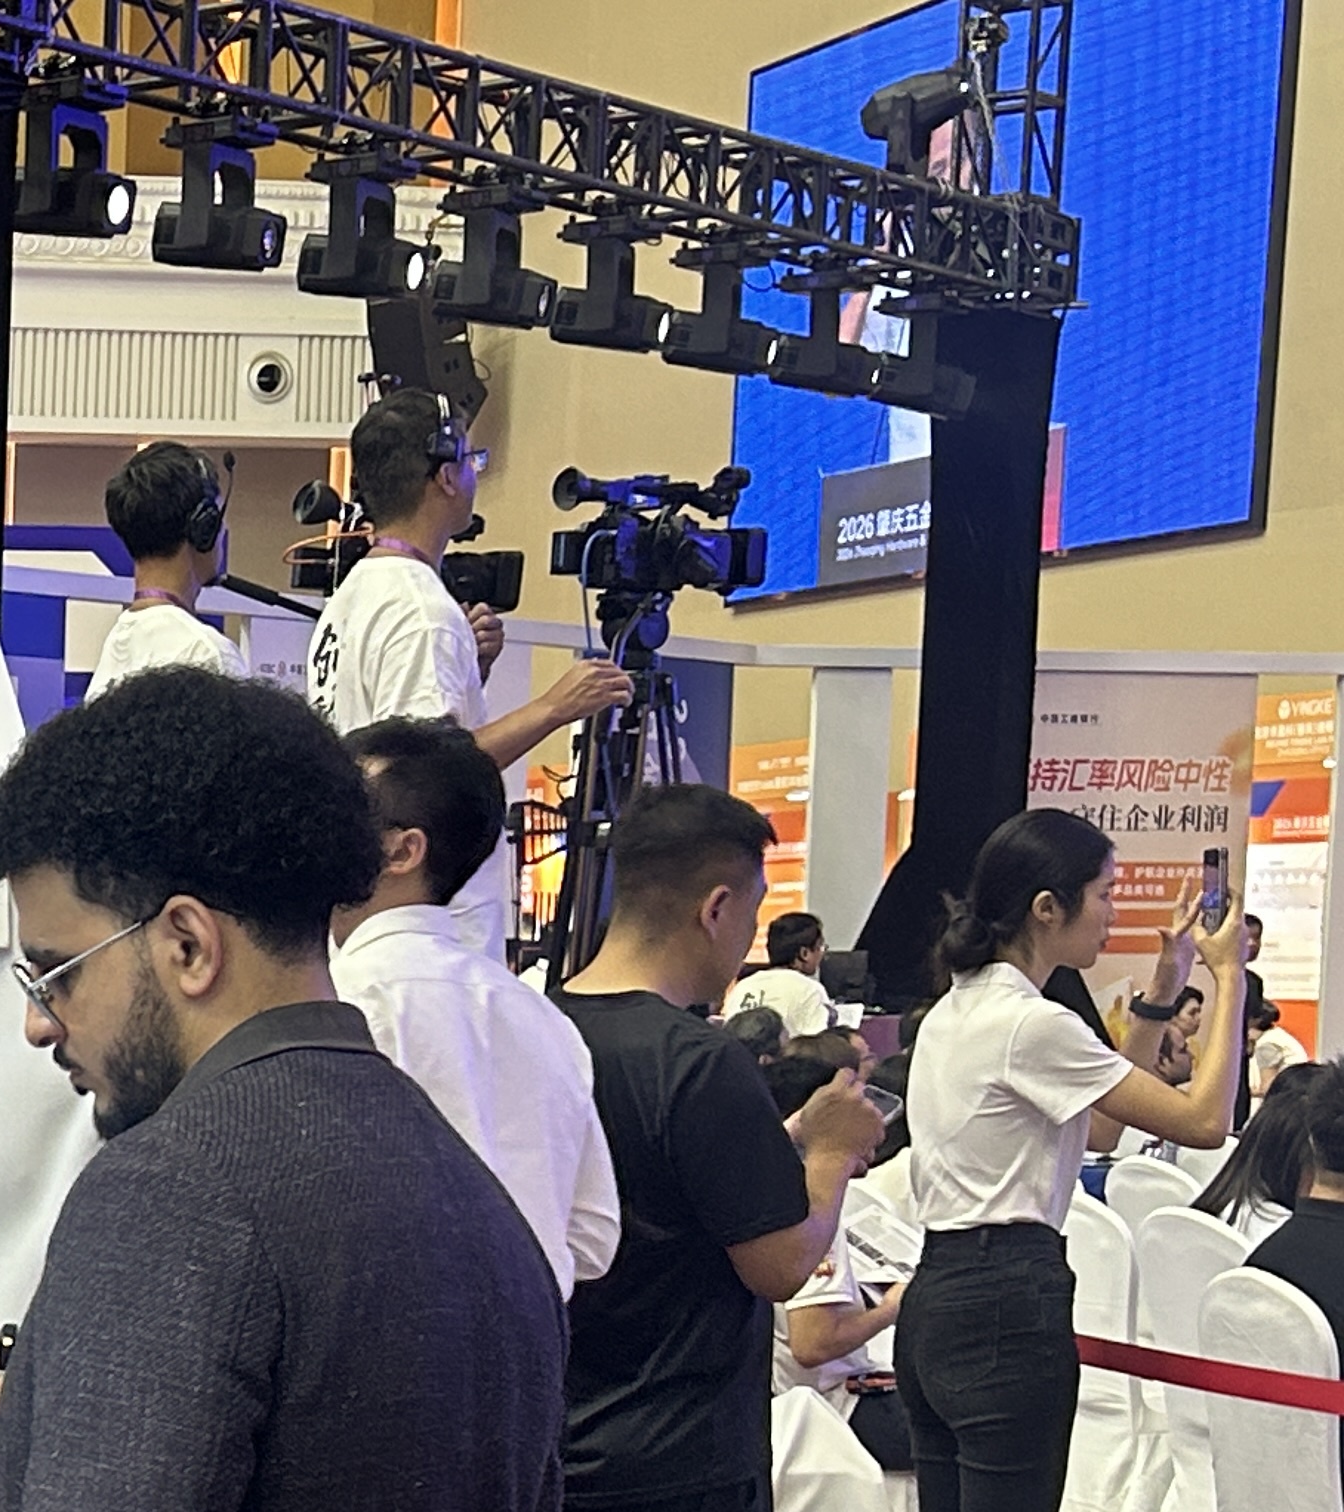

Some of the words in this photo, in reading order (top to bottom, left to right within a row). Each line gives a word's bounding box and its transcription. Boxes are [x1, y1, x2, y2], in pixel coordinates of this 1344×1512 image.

[837, 512, 875, 544] 2026
[1029, 758, 1231, 792] 持汇率风险中性
